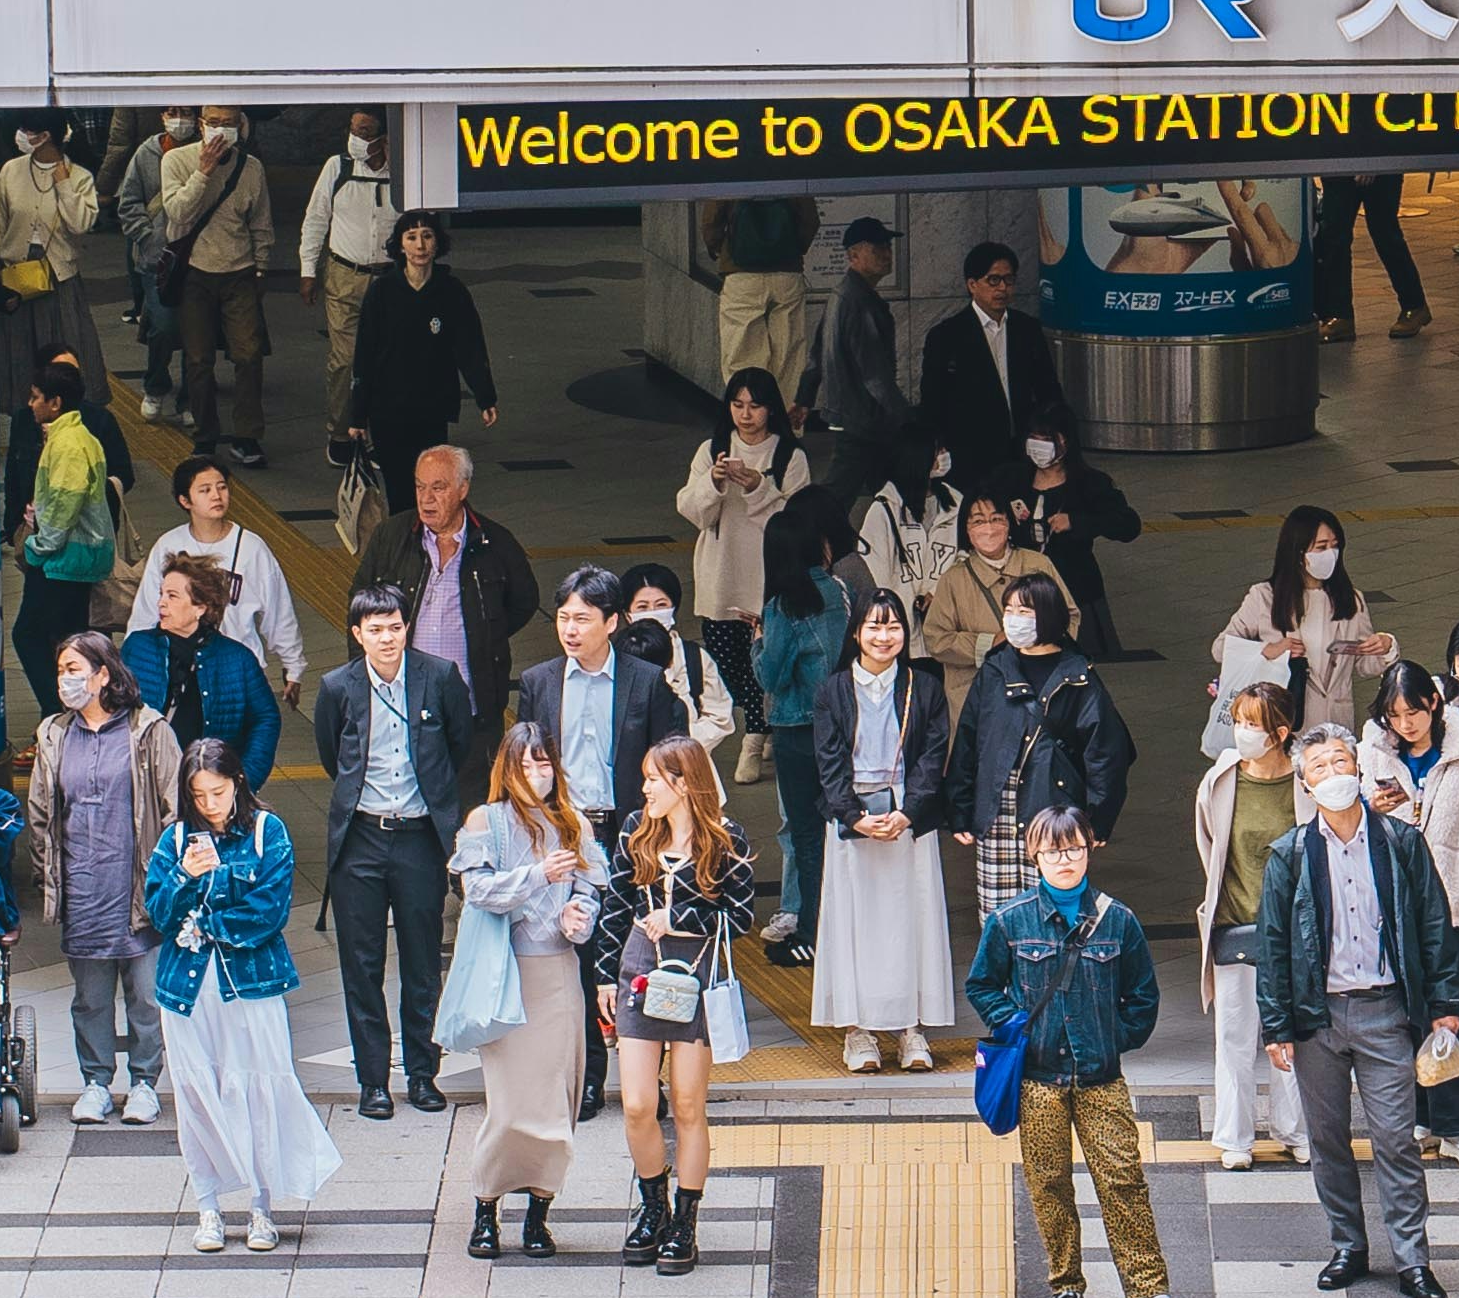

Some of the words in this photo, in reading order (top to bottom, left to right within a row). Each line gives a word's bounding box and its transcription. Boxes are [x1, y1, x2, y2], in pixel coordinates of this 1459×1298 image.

[459, 110, 739, 169] Welcome
[762, 111, 823, 157] to
[843, 100, 1059, 155] OSAKA
[1081, 93, 1351, 147] STATION
[1174, 289, 1237, 305] スマートEX
[900, 541, 956, 584] NY
